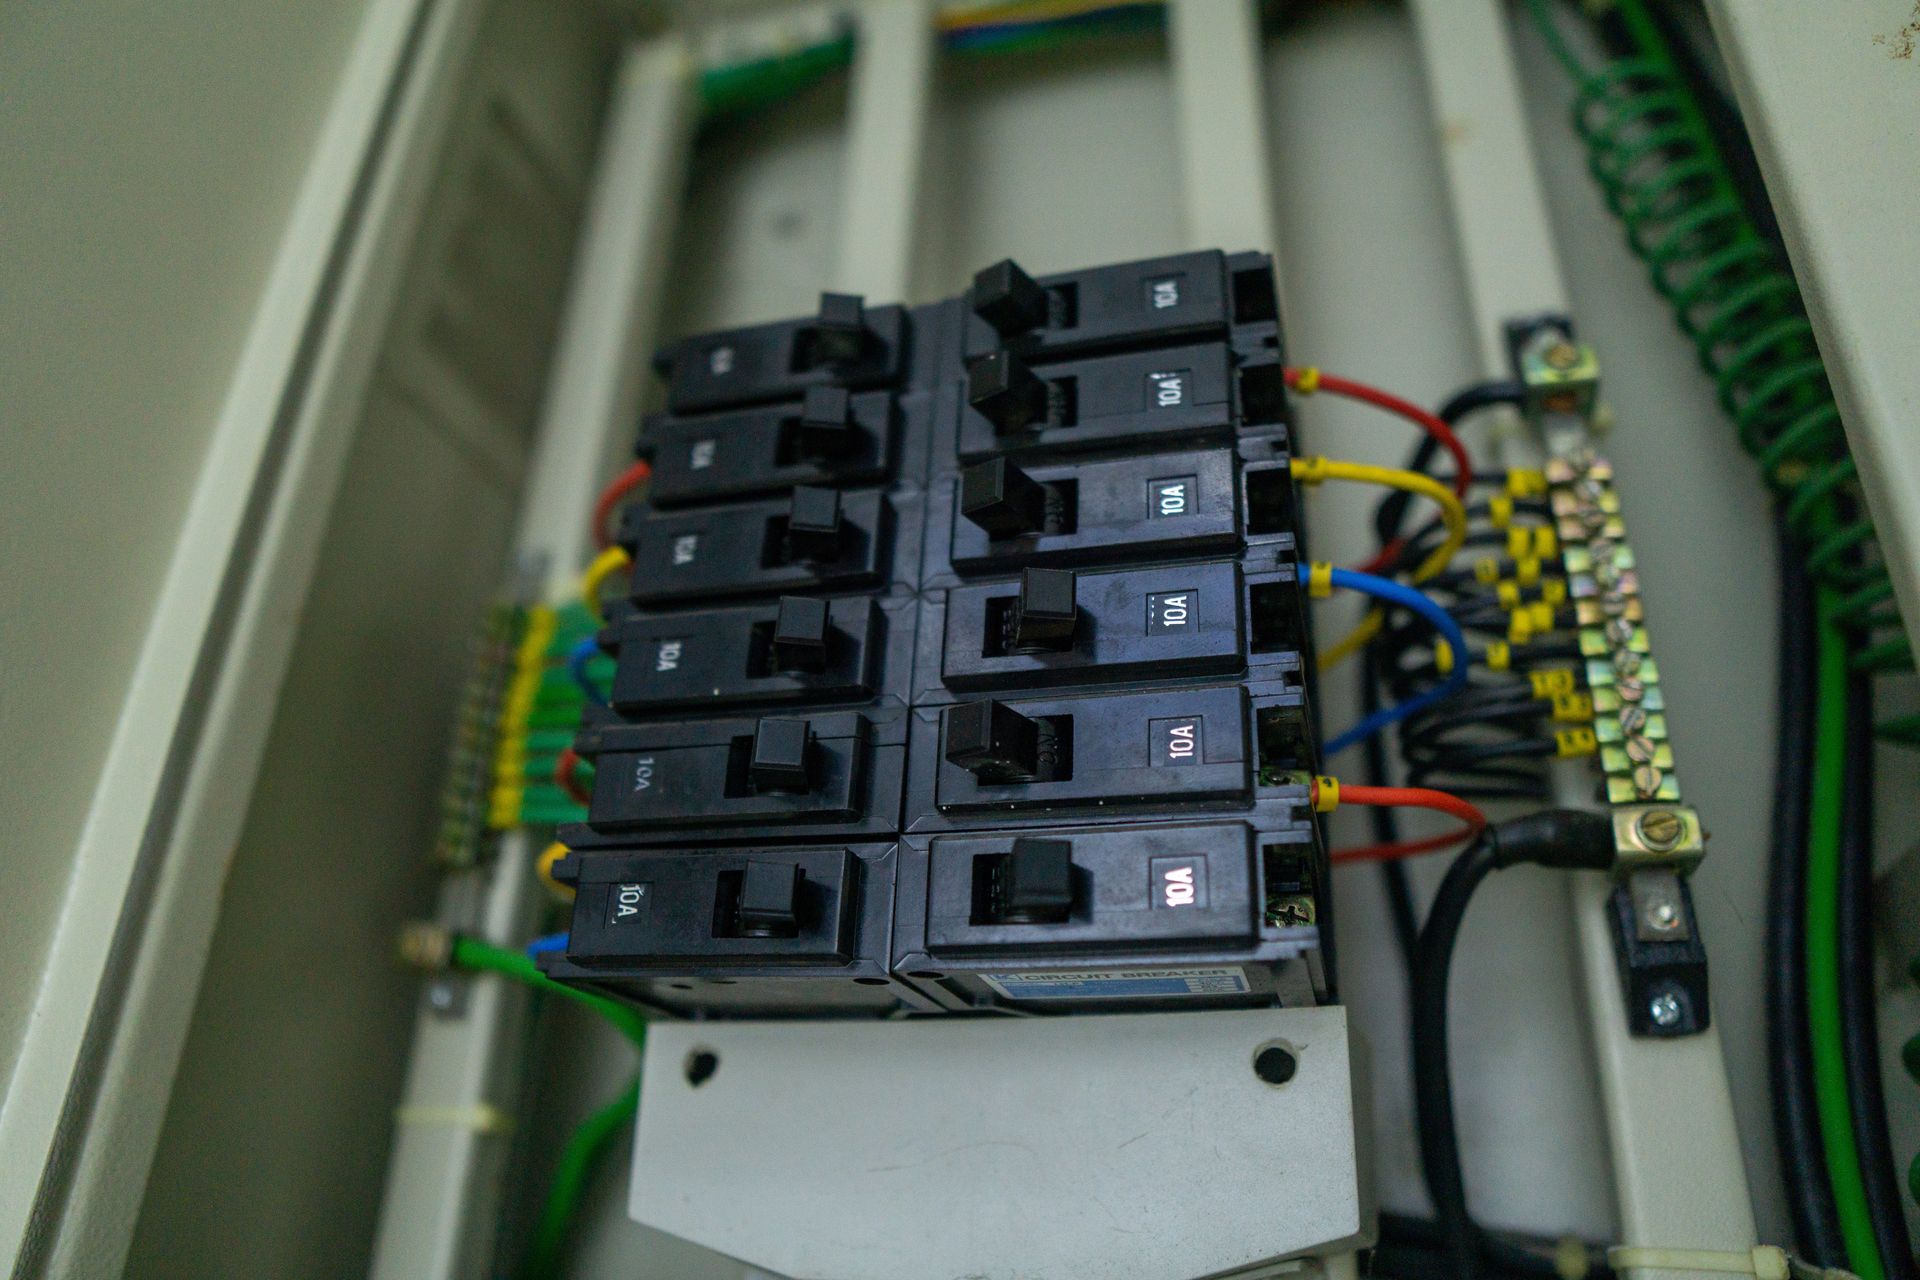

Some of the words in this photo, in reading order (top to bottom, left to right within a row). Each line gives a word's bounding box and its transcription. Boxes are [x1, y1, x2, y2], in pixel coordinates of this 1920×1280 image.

[1154, 280, 1178, 308] 10A
[1158, 378, 1181, 406] 10A
[1161, 484, 1185, 515] 10A
[1163, 595, 1187, 627] 10A
[656, 641, 681, 671] 10A
[1169, 724, 1194, 759] 10A
[634, 757, 655, 793] 10A
[617, 883, 642, 917] 10A
[1164, 866, 1194, 907] 10A
[1025, 973, 1112, 982] CIRCUIT
[1122, 970, 1228, 979] BREAKER
